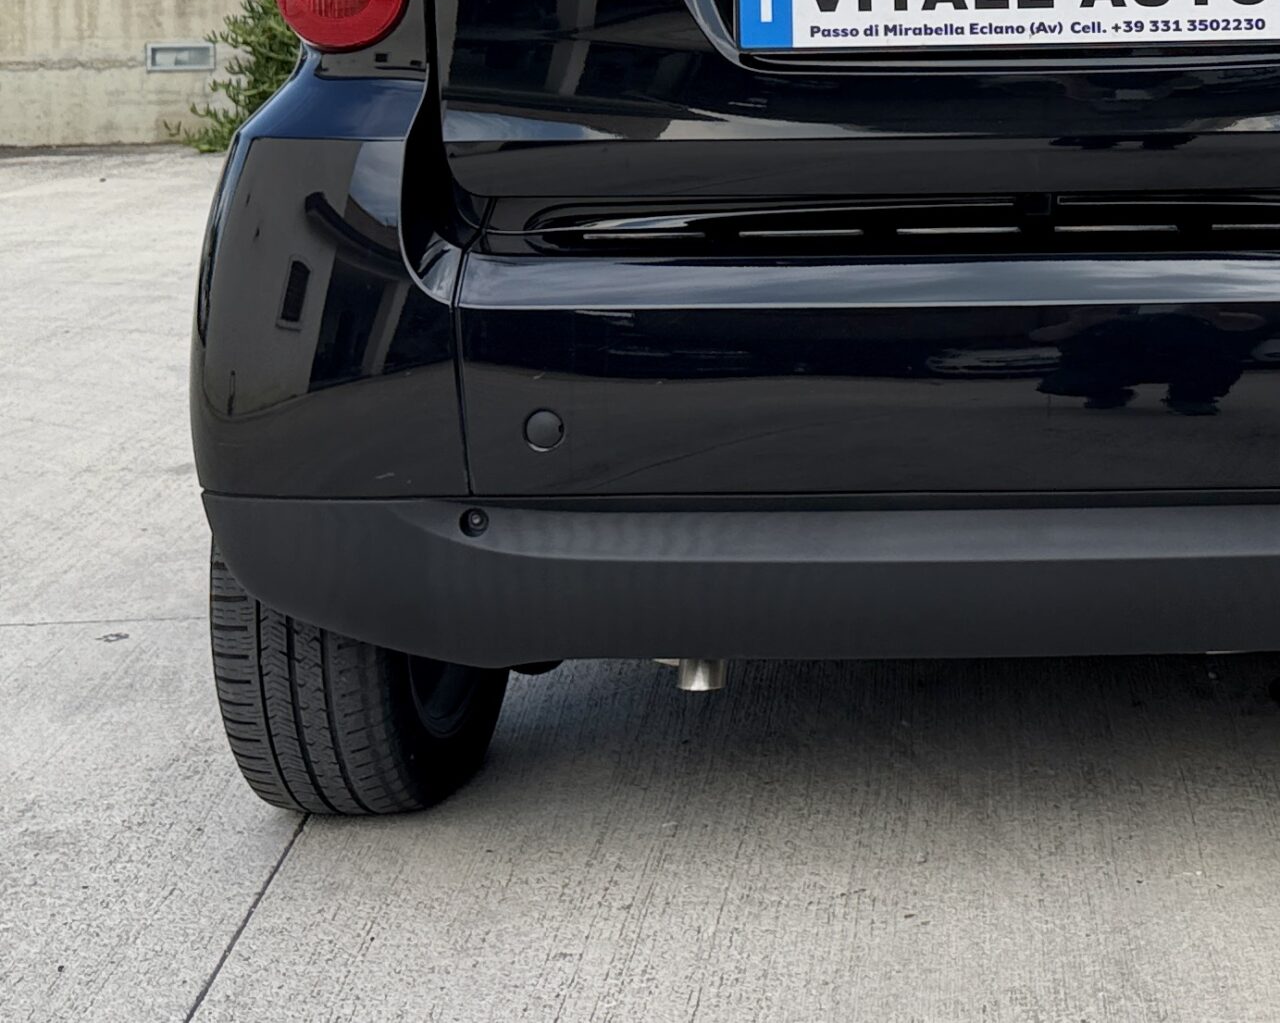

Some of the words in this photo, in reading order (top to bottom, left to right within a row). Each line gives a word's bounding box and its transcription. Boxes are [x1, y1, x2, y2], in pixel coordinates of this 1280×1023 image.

[810, 25, 860, 38] Passo
[863, 24, 879, 37] di
[883, 23, 965, 37] Mirabella
[969, 22, 1026, 35] Eclano
[1029, 21, 1064, 36] (Av)
[1070, 21, 1108, 34] Cell.
[1111, 20, 1145, 33] +39
[1149, 19, 1183, 33] 331
[1186, 18, 1266, 32] 3502230
